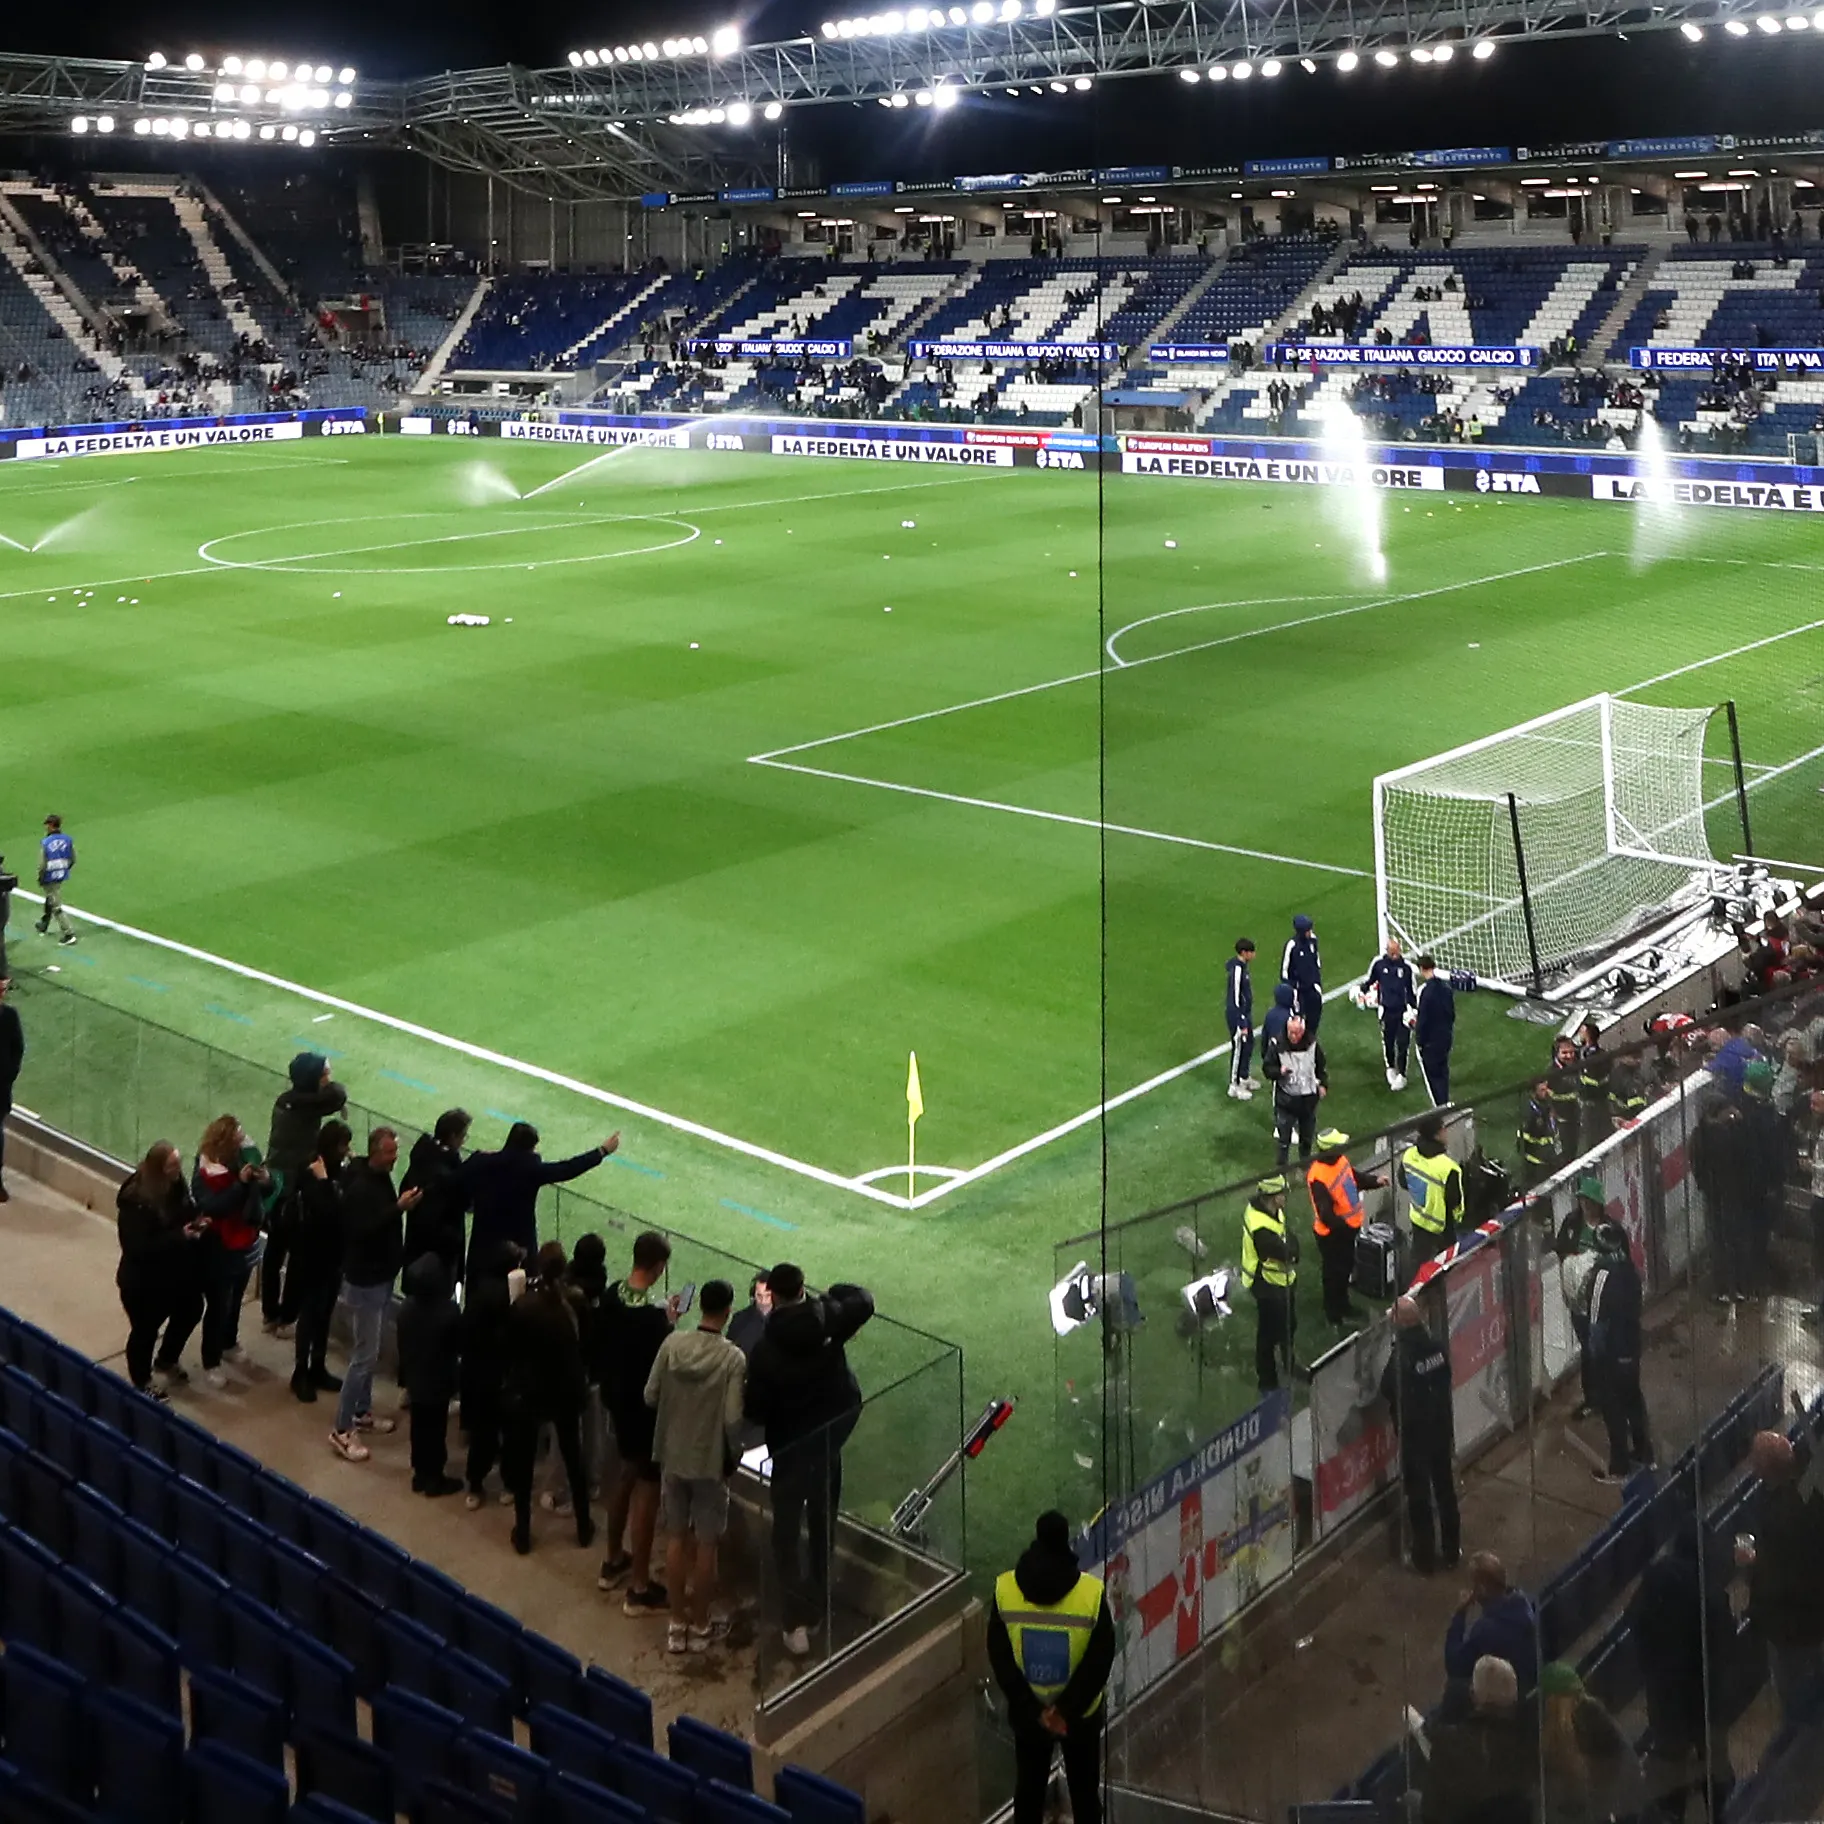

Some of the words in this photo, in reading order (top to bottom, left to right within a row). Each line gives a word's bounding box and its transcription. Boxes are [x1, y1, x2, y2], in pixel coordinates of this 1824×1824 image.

[985, 345, 1025, 357] ITALIANA
[1364, 349, 1413, 362] ITALIANA
[1418, 349, 1466, 363] GIUOCO
[1469, 350, 1515, 364] CALCIO
[45, 439, 68, 454] LA
[175, 431, 201, 446] UN
[205, 427, 274, 444] VALORE
[509, 427, 527, 438] LA
[598, 431, 618, 443] UN
[783, 439, 803, 454] LA
[895, 445, 920, 461] UN
[925, 446, 997, 465] VALORE
[1136, 457, 1161, 474] LA
[1285, 464, 1320, 483] UN
[1326, 465, 1422, 487] VAORE
[1612, 480, 1647, 500] LA
